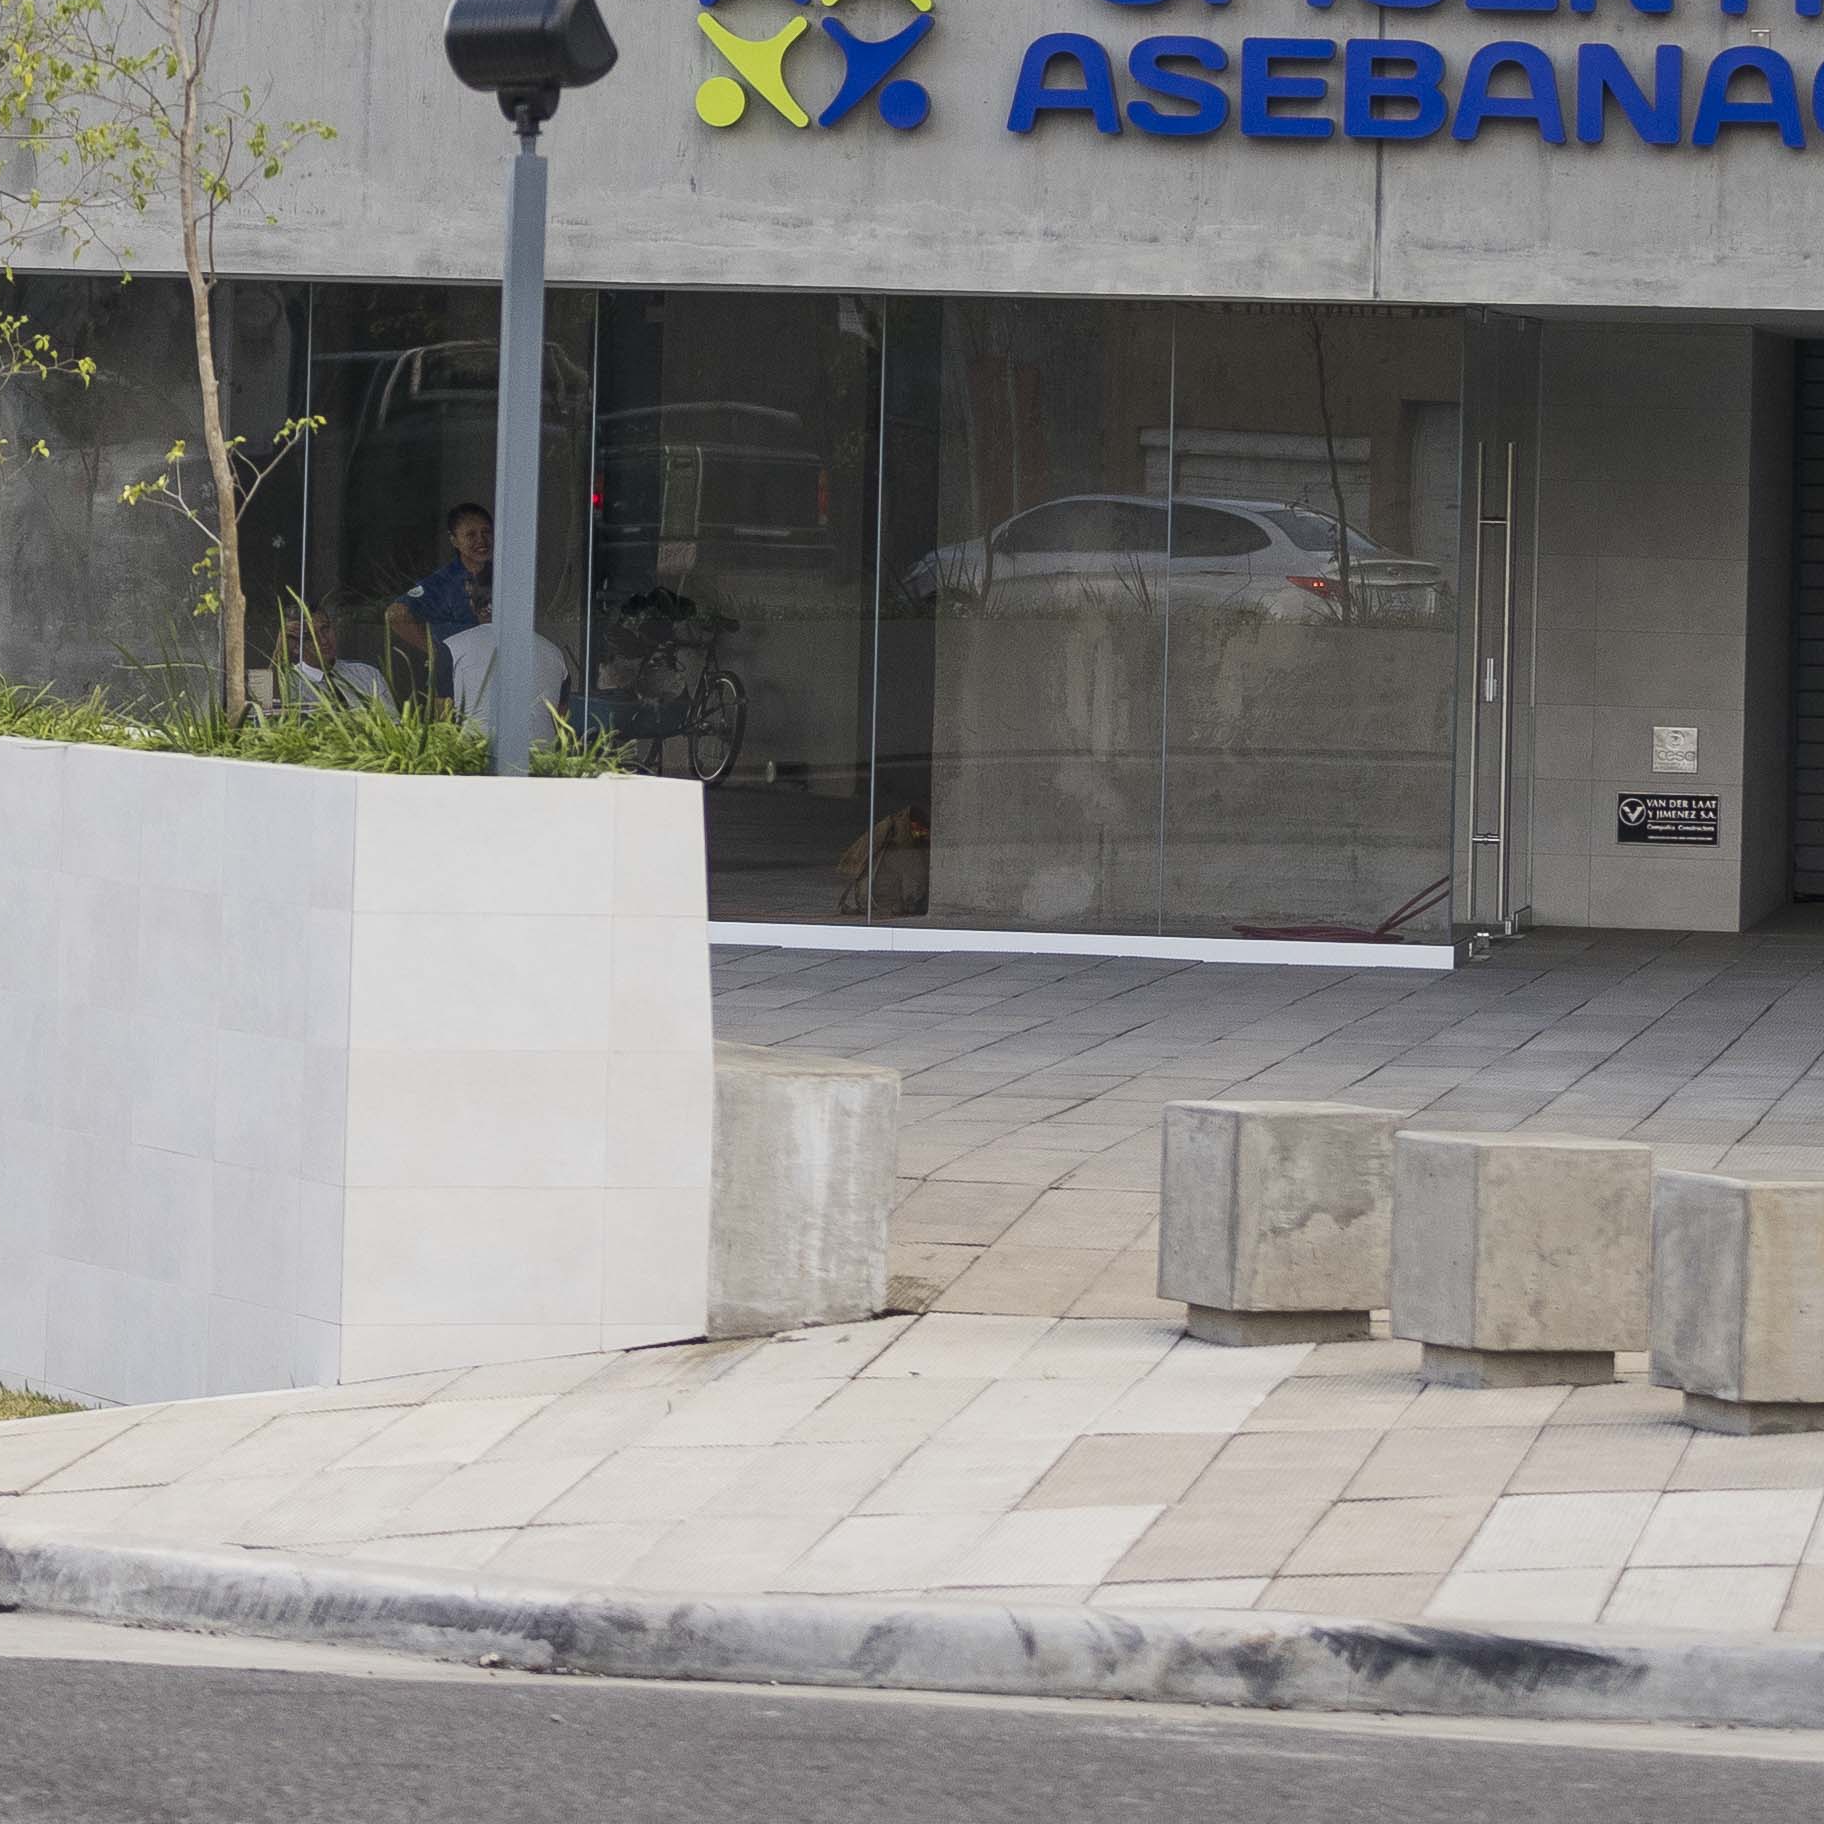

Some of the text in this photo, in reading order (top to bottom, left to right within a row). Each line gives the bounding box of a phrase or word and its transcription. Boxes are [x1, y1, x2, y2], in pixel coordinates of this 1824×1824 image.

[1646, 799, 1717, 809] VAN DER LAAT
[1647, 810, 1653, 818] Y
[1656, 810, 1696, 819] JIMENEZ
